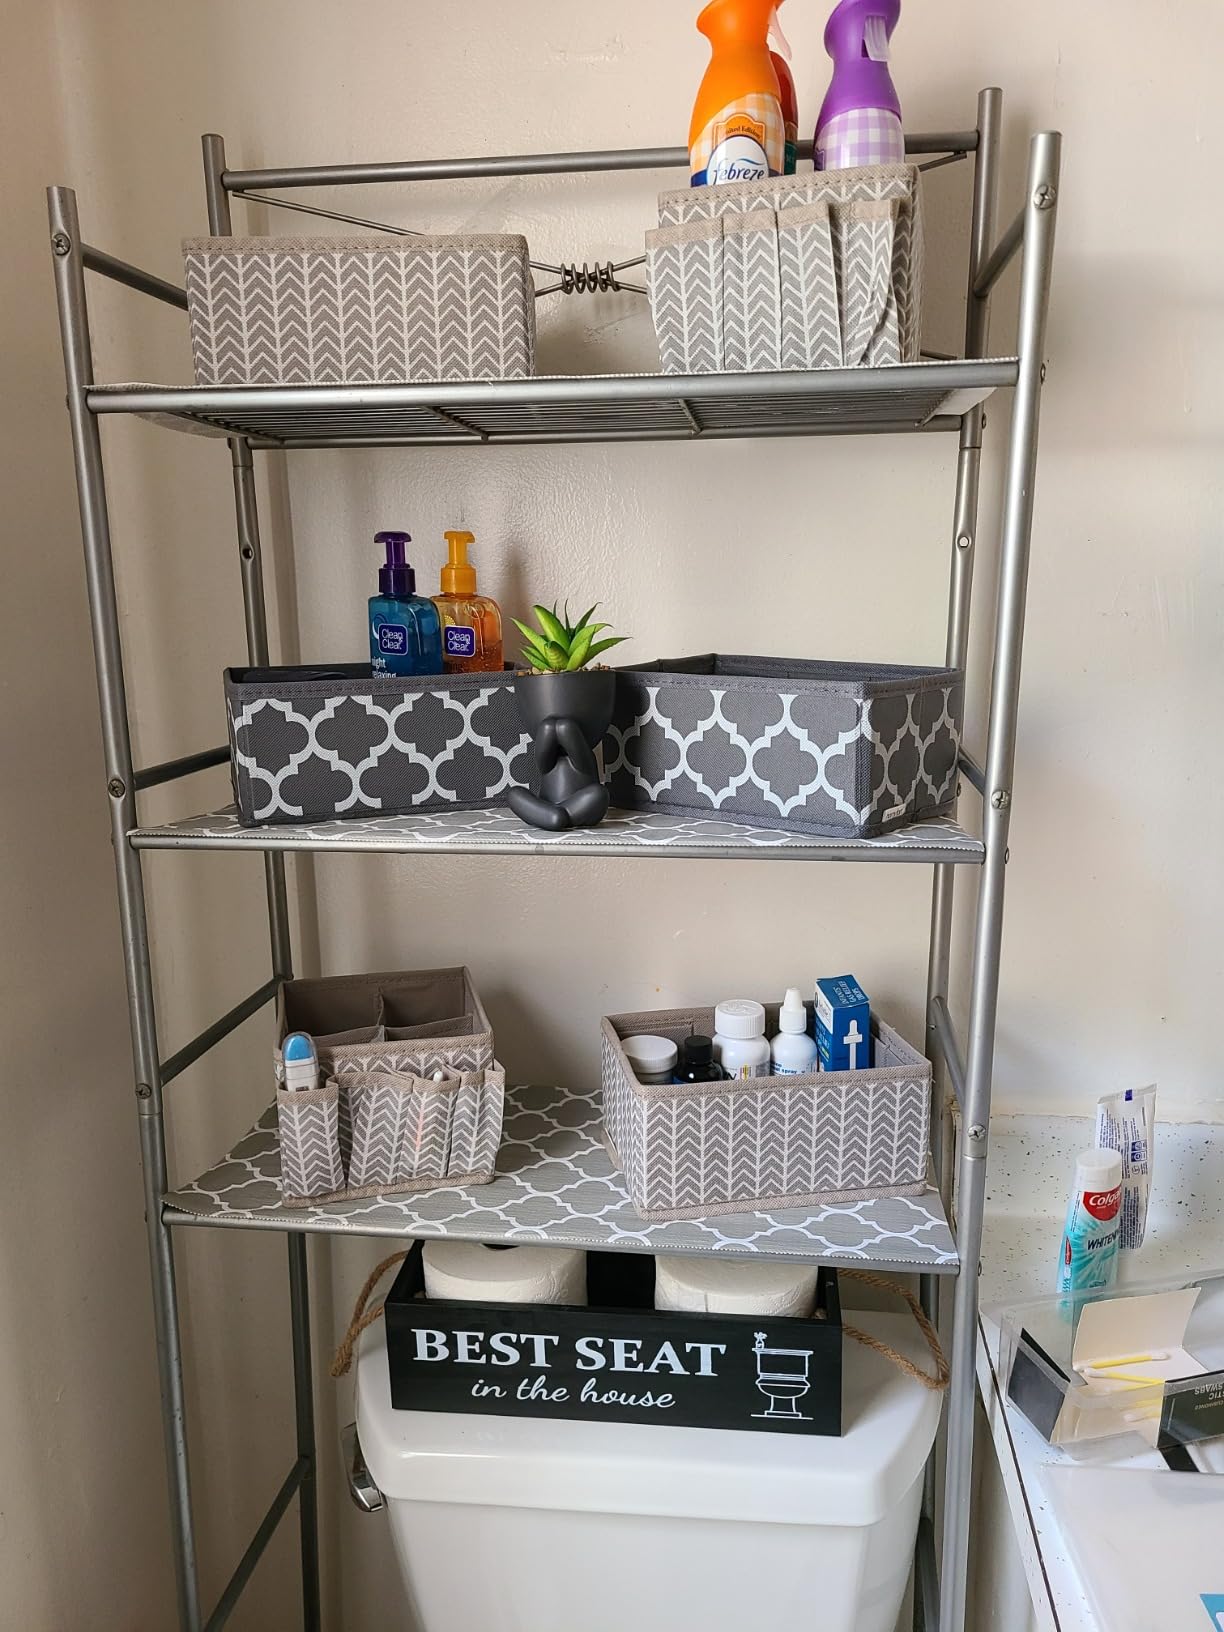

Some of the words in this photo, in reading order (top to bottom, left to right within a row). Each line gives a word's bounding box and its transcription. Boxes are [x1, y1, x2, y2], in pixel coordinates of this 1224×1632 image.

[381, 628, 404, 640] Clean
[447, 630, 471, 641] Clean
[1089, 1189, 1121, 1208] Colga
[411, 1328, 558, 1368] BEST
[575, 1337, 727, 1376] SEAT
[472, 1377, 506, 1397] in
[517, 1374, 569, 1402] the
[579, 1378, 677, 1408] house
